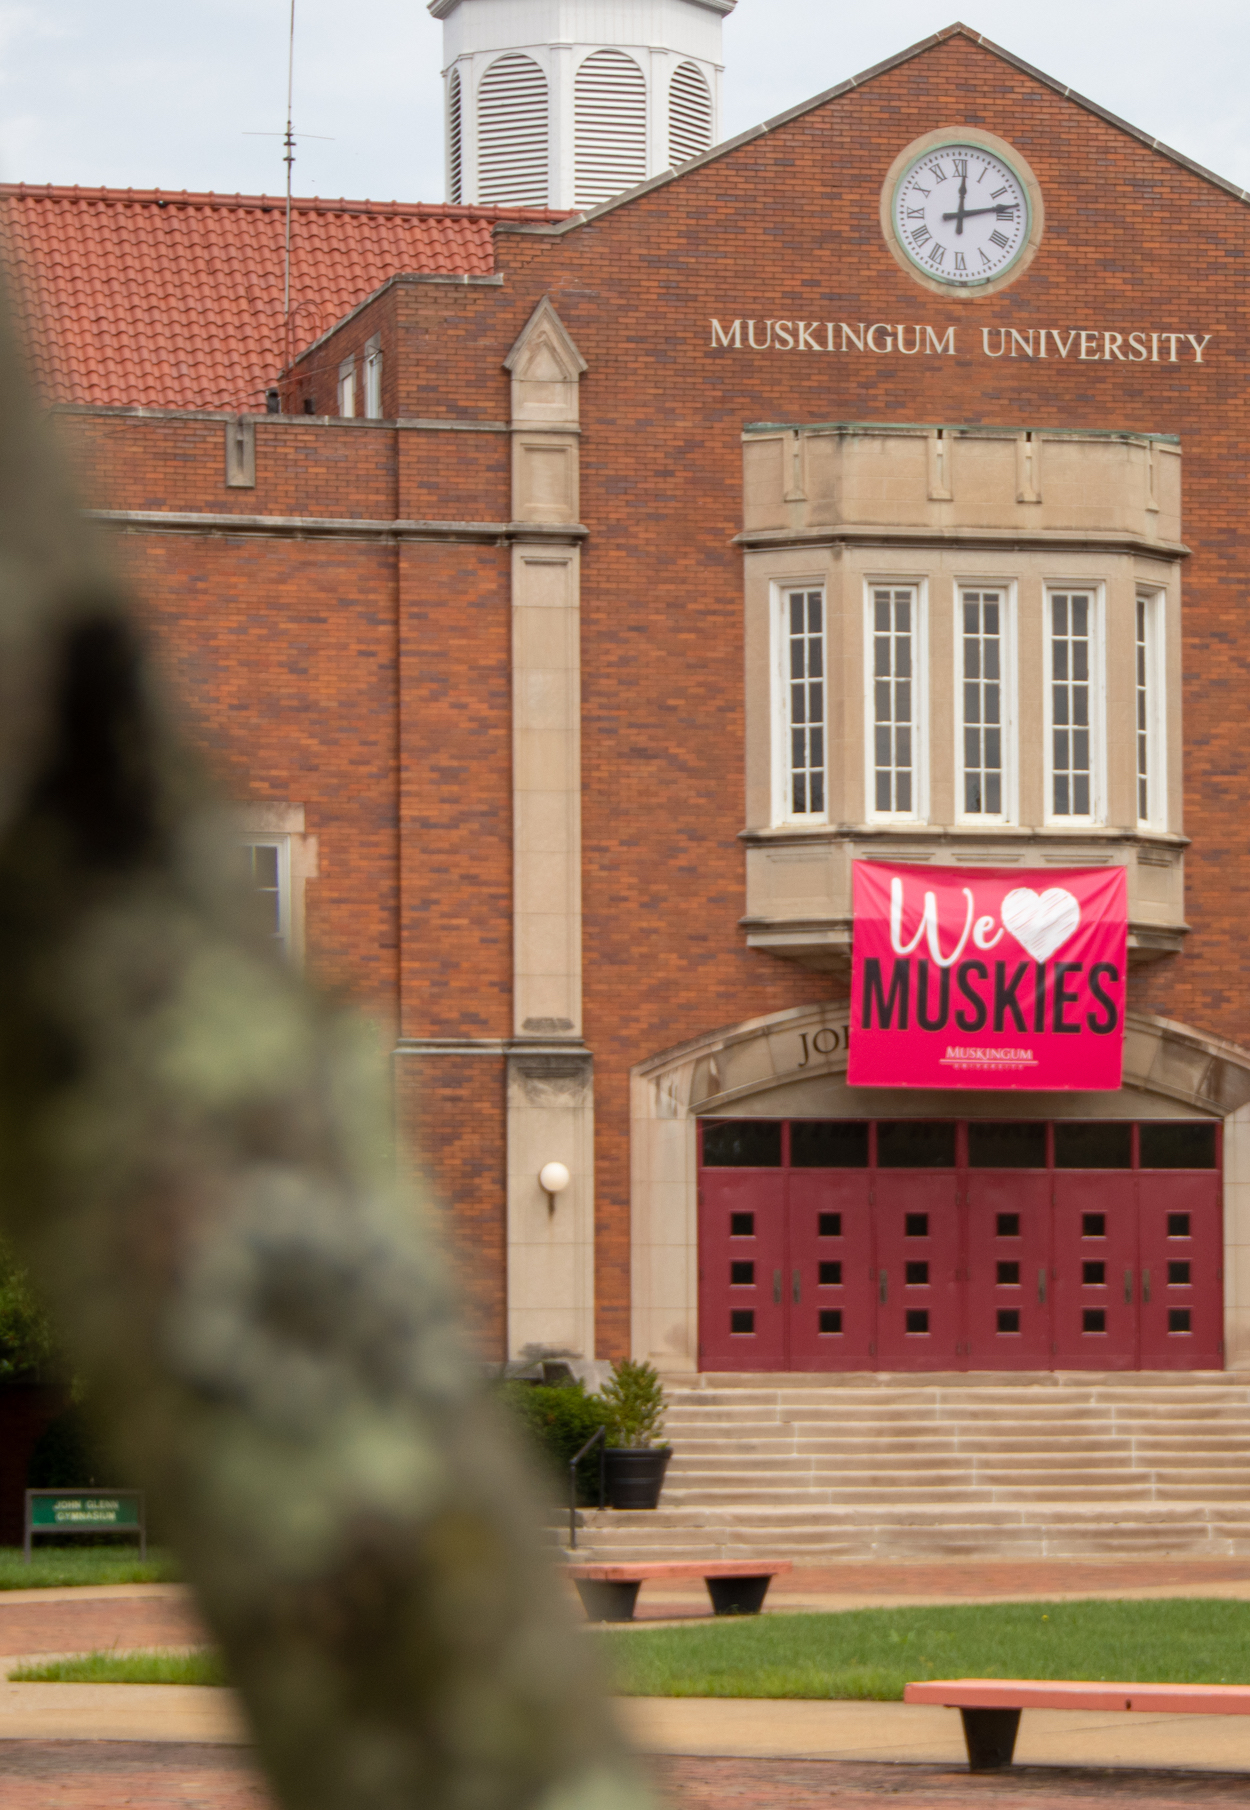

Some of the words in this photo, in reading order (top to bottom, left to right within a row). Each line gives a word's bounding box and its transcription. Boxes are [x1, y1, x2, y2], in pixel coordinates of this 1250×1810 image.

[928, 163, 947, 184] XI
[912, 182, 931, 199] X
[990, 186, 1008, 200] II
[977, 247, 991, 266] V
[708, 318, 958, 355] MUSKINGUM
[980, 327, 1213, 363] UNIVERSITY
[890, 877, 1004, 967] We
[861, 957, 1119, 1035] MUSKIES
[945, 1046, 1033, 1061] MUSKINGUM
[54, 1500, 81, 1510] JOHN
[56, 1511, 116, 1521] GYMNASIUM
